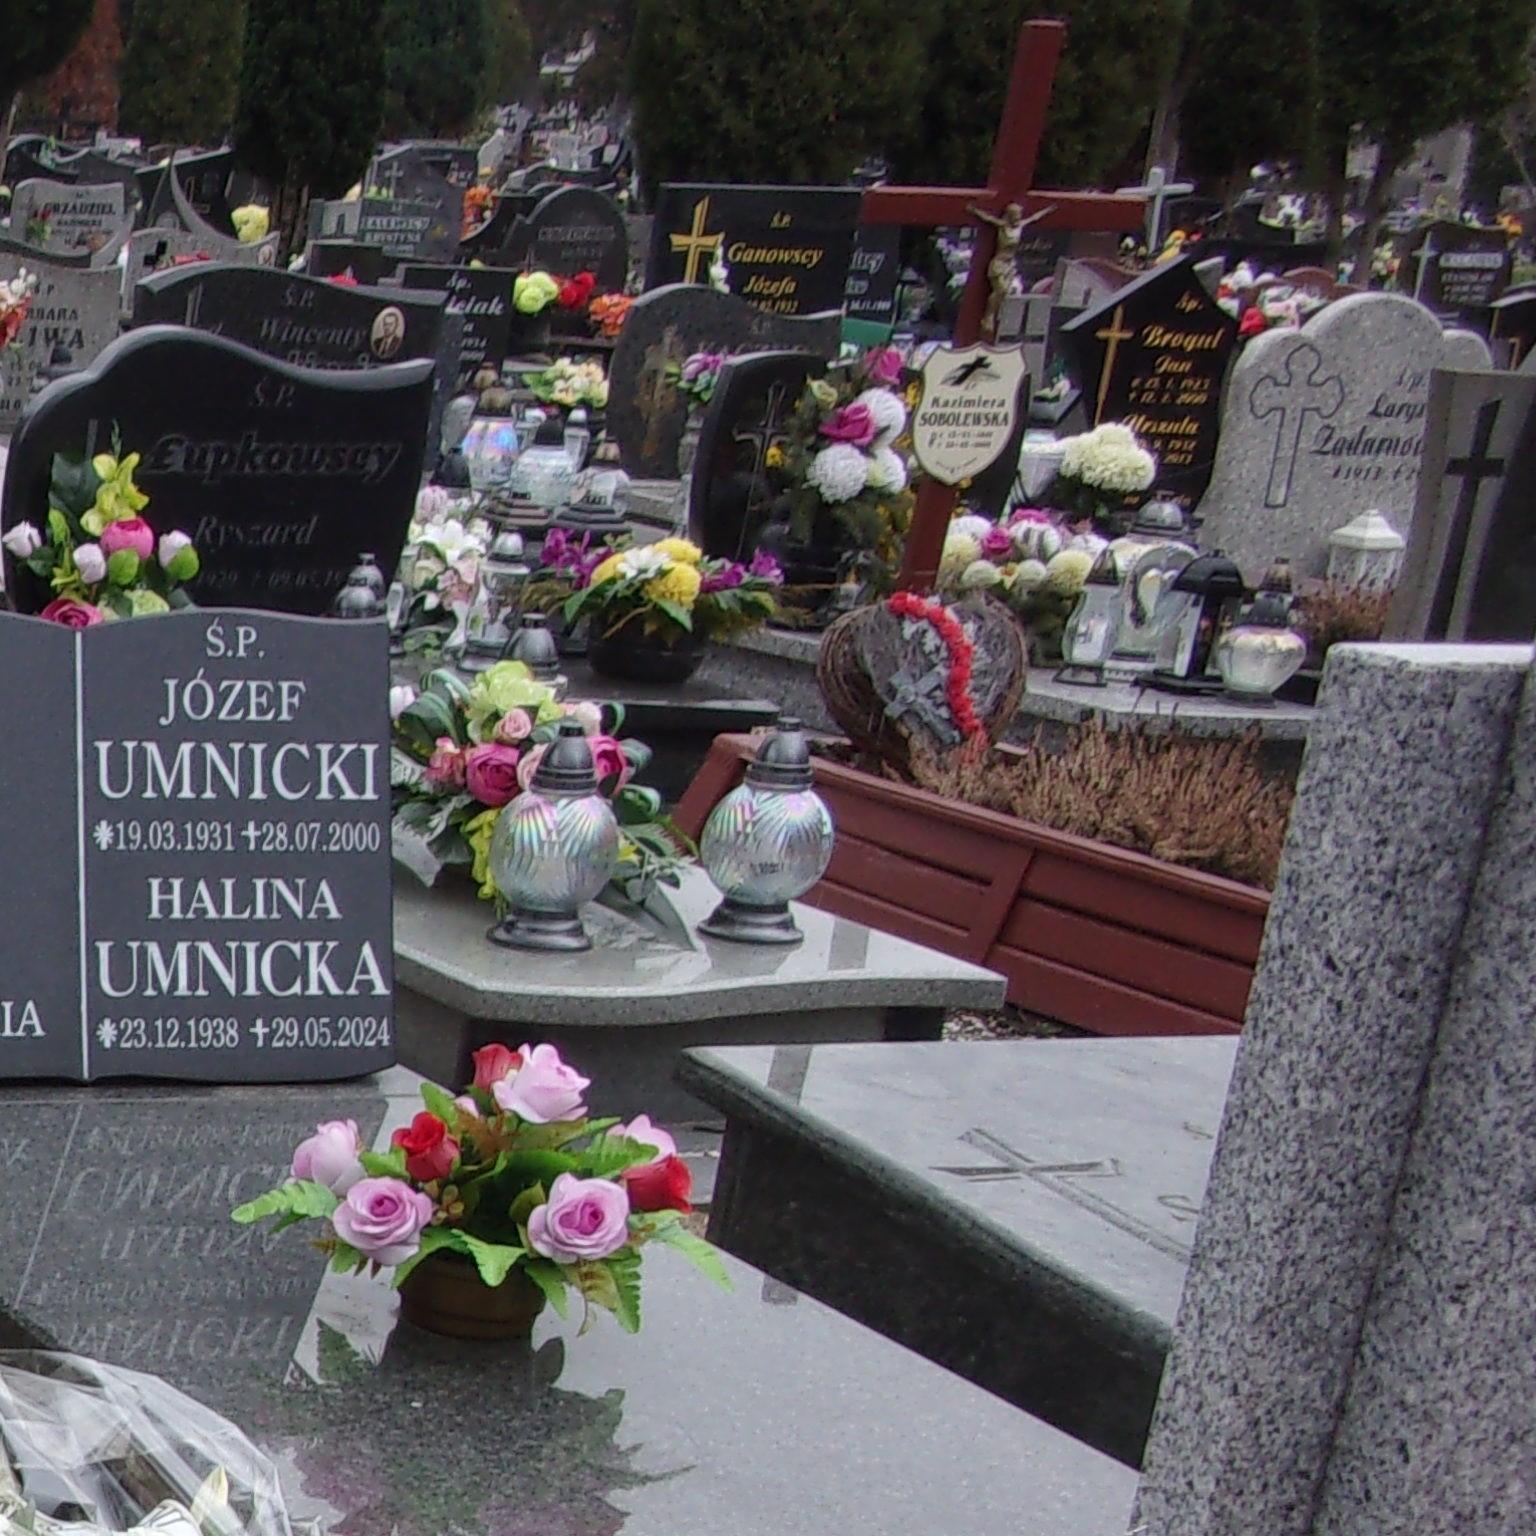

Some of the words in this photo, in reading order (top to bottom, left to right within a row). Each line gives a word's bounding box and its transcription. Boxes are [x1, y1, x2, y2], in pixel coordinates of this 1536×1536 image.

[727, 242, 824, 269] Ganowscy
[743, 275, 797, 298] Józefa
[259, 317, 367, 350] Wincenty
[1155, 355, 1193, 374] Jan
[931, 394, 1006, 408] Kazimiera
[919, 411, 1009, 427] SOBOLEWSKA
[205, 616, 264, 658] Ś.P.
[159, 669, 306, 724] JÓZEF
[95, 741, 380, 800] UMNICKI
[115, 821, 235, 853] 19.03.1931
[261, 820, 381, 853] 28.07.2000
[148, 877, 342, 920] HALINA
[95, 940, 391, 998] UMNICKA
[119, 1016, 239, 1050] 23.12.1938
[271, 1015, 391, 1049] 29.05.2024
